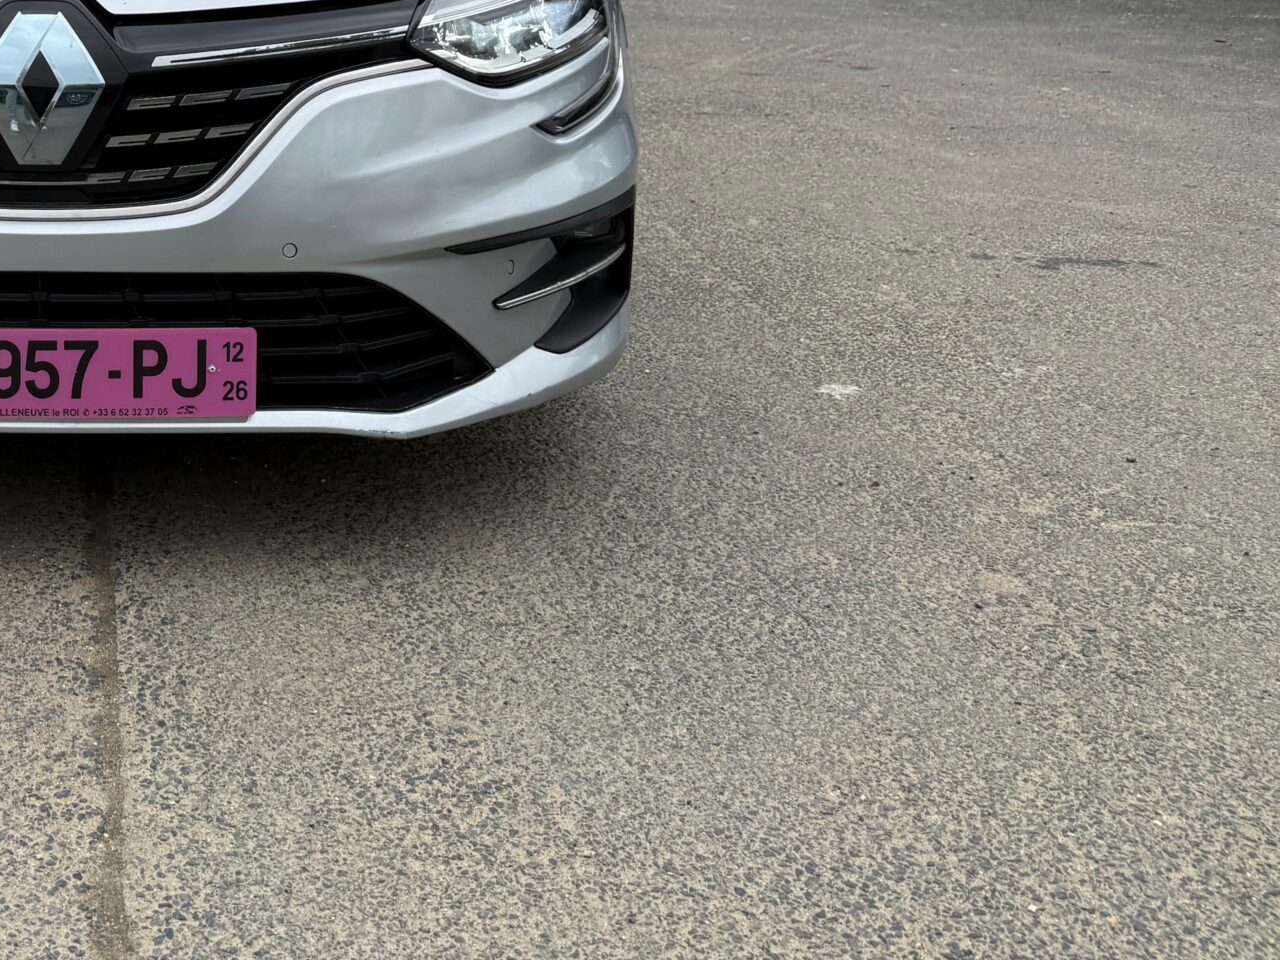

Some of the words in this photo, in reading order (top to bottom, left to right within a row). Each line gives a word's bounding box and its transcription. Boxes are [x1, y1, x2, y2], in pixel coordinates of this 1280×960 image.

[222, 341, 244, 362] 12
[222, 380, 248, 401] 26
[52, 408, 60, 416] le
[63, 408, 79, 416] ROI
[93, 408, 108, 416] +33
[111, 408, 116, 416] 6
[119, 408, 129, 416] 52
[132, 408, 142, 416] 32
[145, 408, 155, 416] 37
